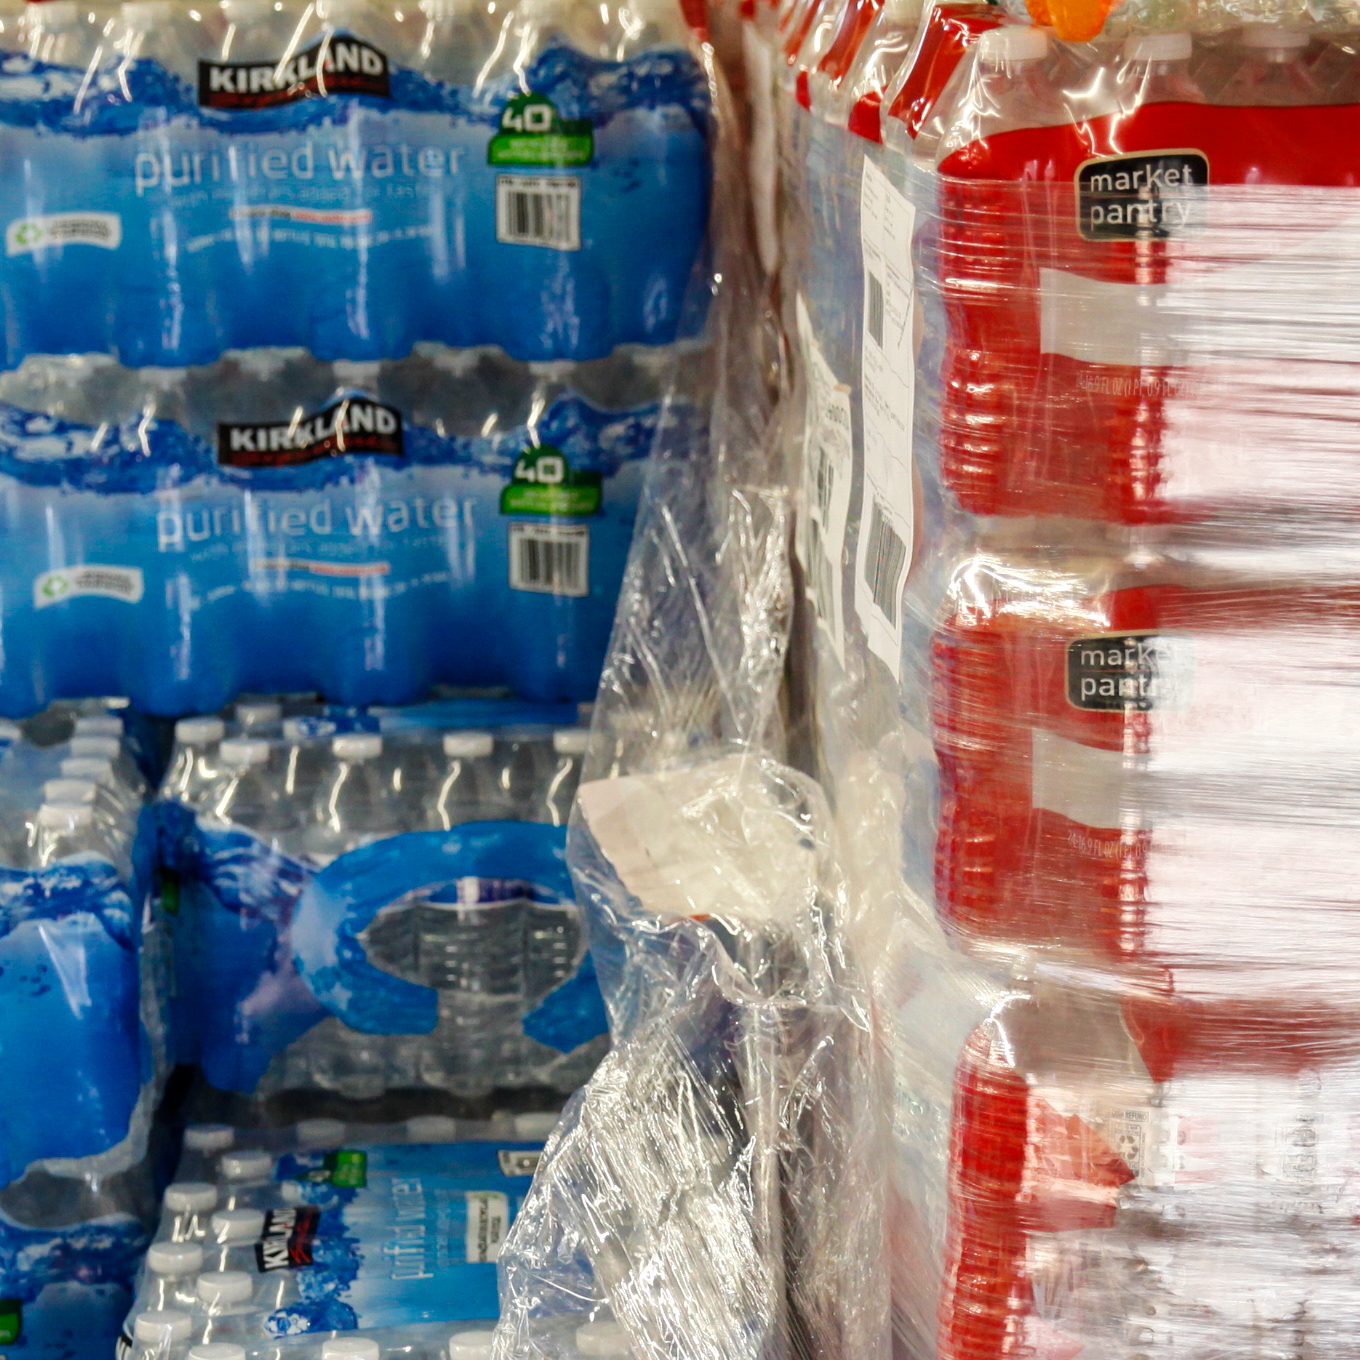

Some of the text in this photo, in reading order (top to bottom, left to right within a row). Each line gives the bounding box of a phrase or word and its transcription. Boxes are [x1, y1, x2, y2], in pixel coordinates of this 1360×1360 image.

[209, 43, 384, 93] KIRKLAND
[501, 103, 553, 133] 40
[135, 141, 315, 198] purified
[325, 145, 466, 180] water
[1090, 163, 1193, 193] market
[1090, 196, 1192, 232] pantry
[230, 404, 397, 452] KIRKLAND
[515, 455, 565, 484] 40
[156, 502, 332, 553] purified
[346, 497, 478, 537] water
[1080, 642, 1172, 667] marke
[1080, 675, 1164, 702] pantr
